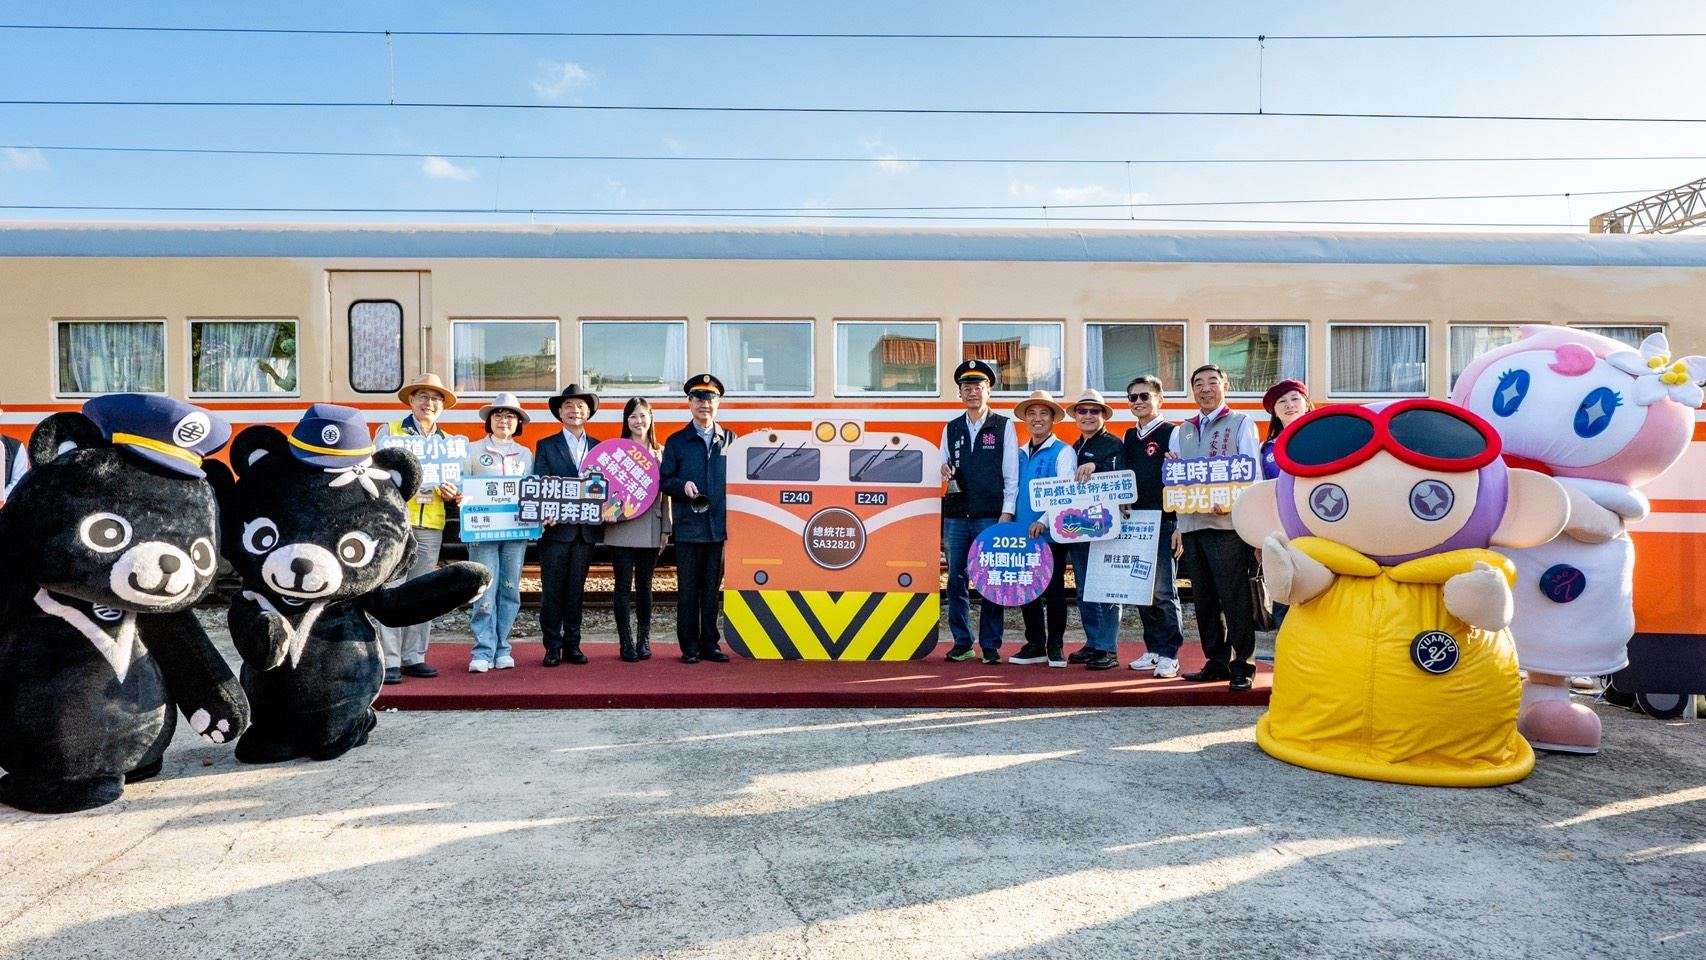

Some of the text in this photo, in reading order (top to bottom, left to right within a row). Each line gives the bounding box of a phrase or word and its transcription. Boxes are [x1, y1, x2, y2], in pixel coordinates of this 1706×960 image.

[628, 446, 653, 471] 2025
[420, 462, 461, 482] 富岡
[597, 451, 648, 500] 藝術生活節
[611, 447, 653, 489] 富岡鐵道
[1165, 457, 1253, 483] 準時富約
[486, 482, 516, 496] 富岡
[521, 479, 580, 499] 向桃園
[782, 492, 810, 503] E240
[1033, 479, 1132, 499] 富岡鐵道藝術生活節
[857, 494, 885, 504] E240
[520, 500, 600, 522] 富岡奔跑
[813, 526, 856, 538] 總統花車
[813, 539, 856, 550] SA32820
[992, 536, 1027, 549] 2025
[979, 551, 1041, 568] 桃園仙草
[987, 570, 1034, 586] 嘉年華
[1420, 635, 1456, 652] YUANGO
